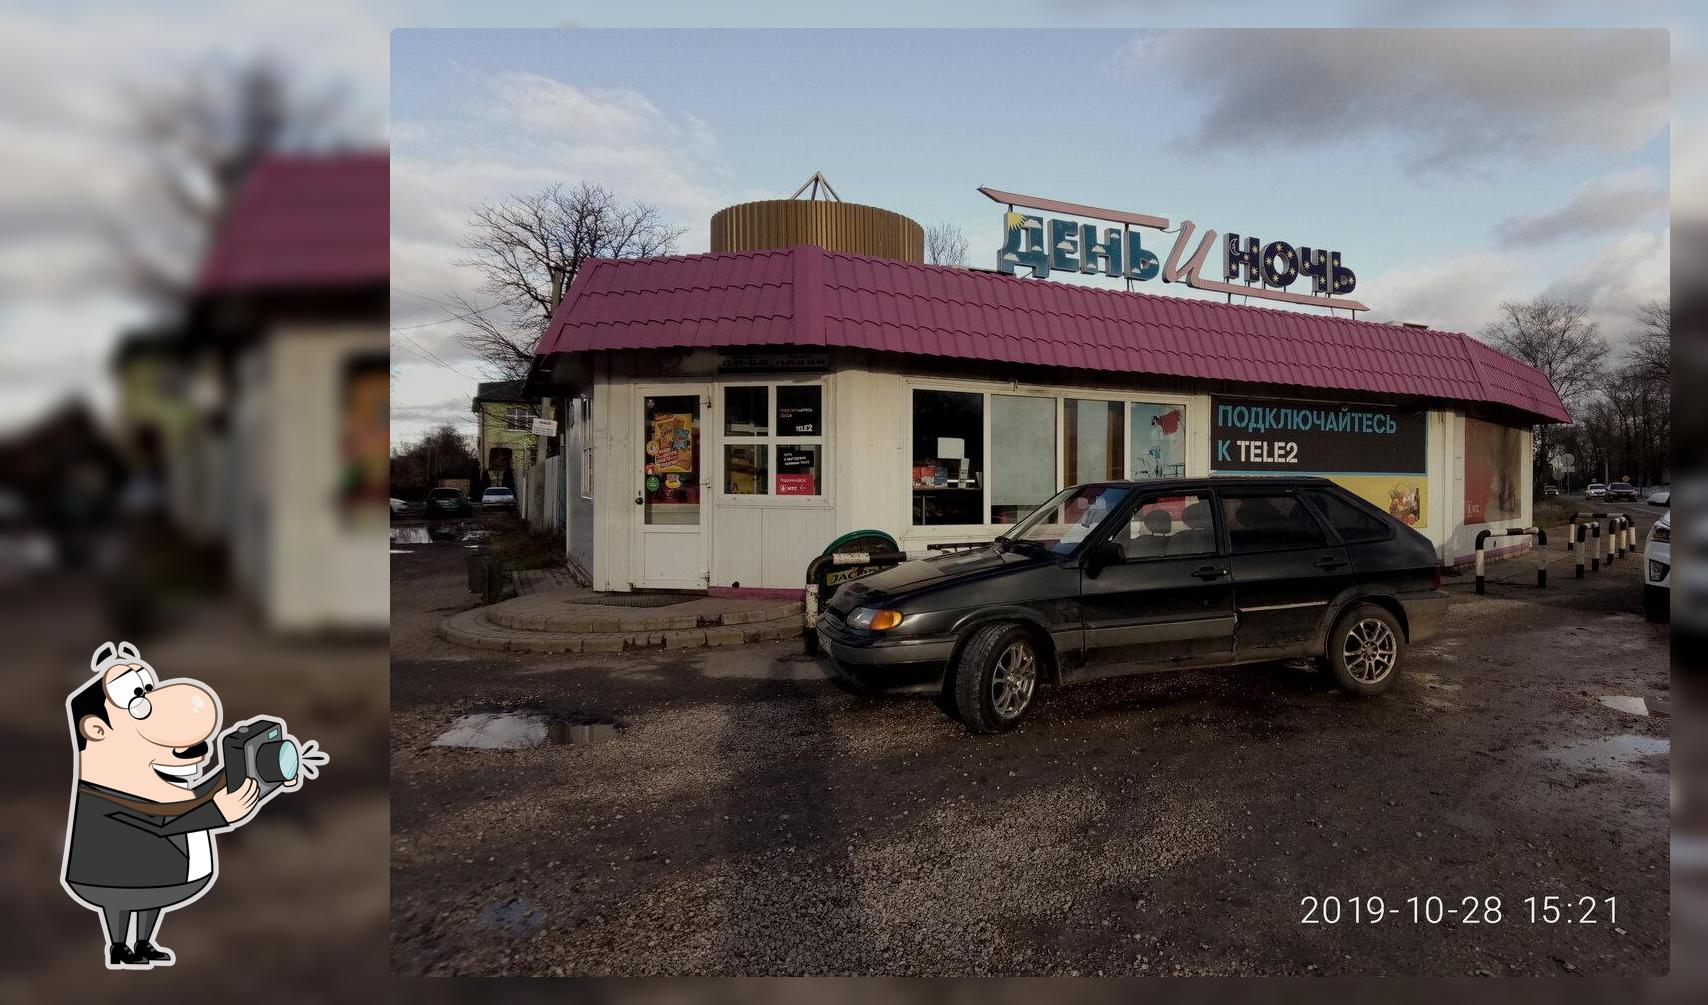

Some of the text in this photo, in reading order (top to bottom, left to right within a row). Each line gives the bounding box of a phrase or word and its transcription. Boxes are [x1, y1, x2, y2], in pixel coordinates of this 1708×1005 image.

[997, 211, 1356, 294] ДЕНЬ И НОЧЬ
[1218, 404, 1397, 434] ПОДКЛЮЧАЙТЕСЬ
[1217, 440, 1298, 463] К TELE2
